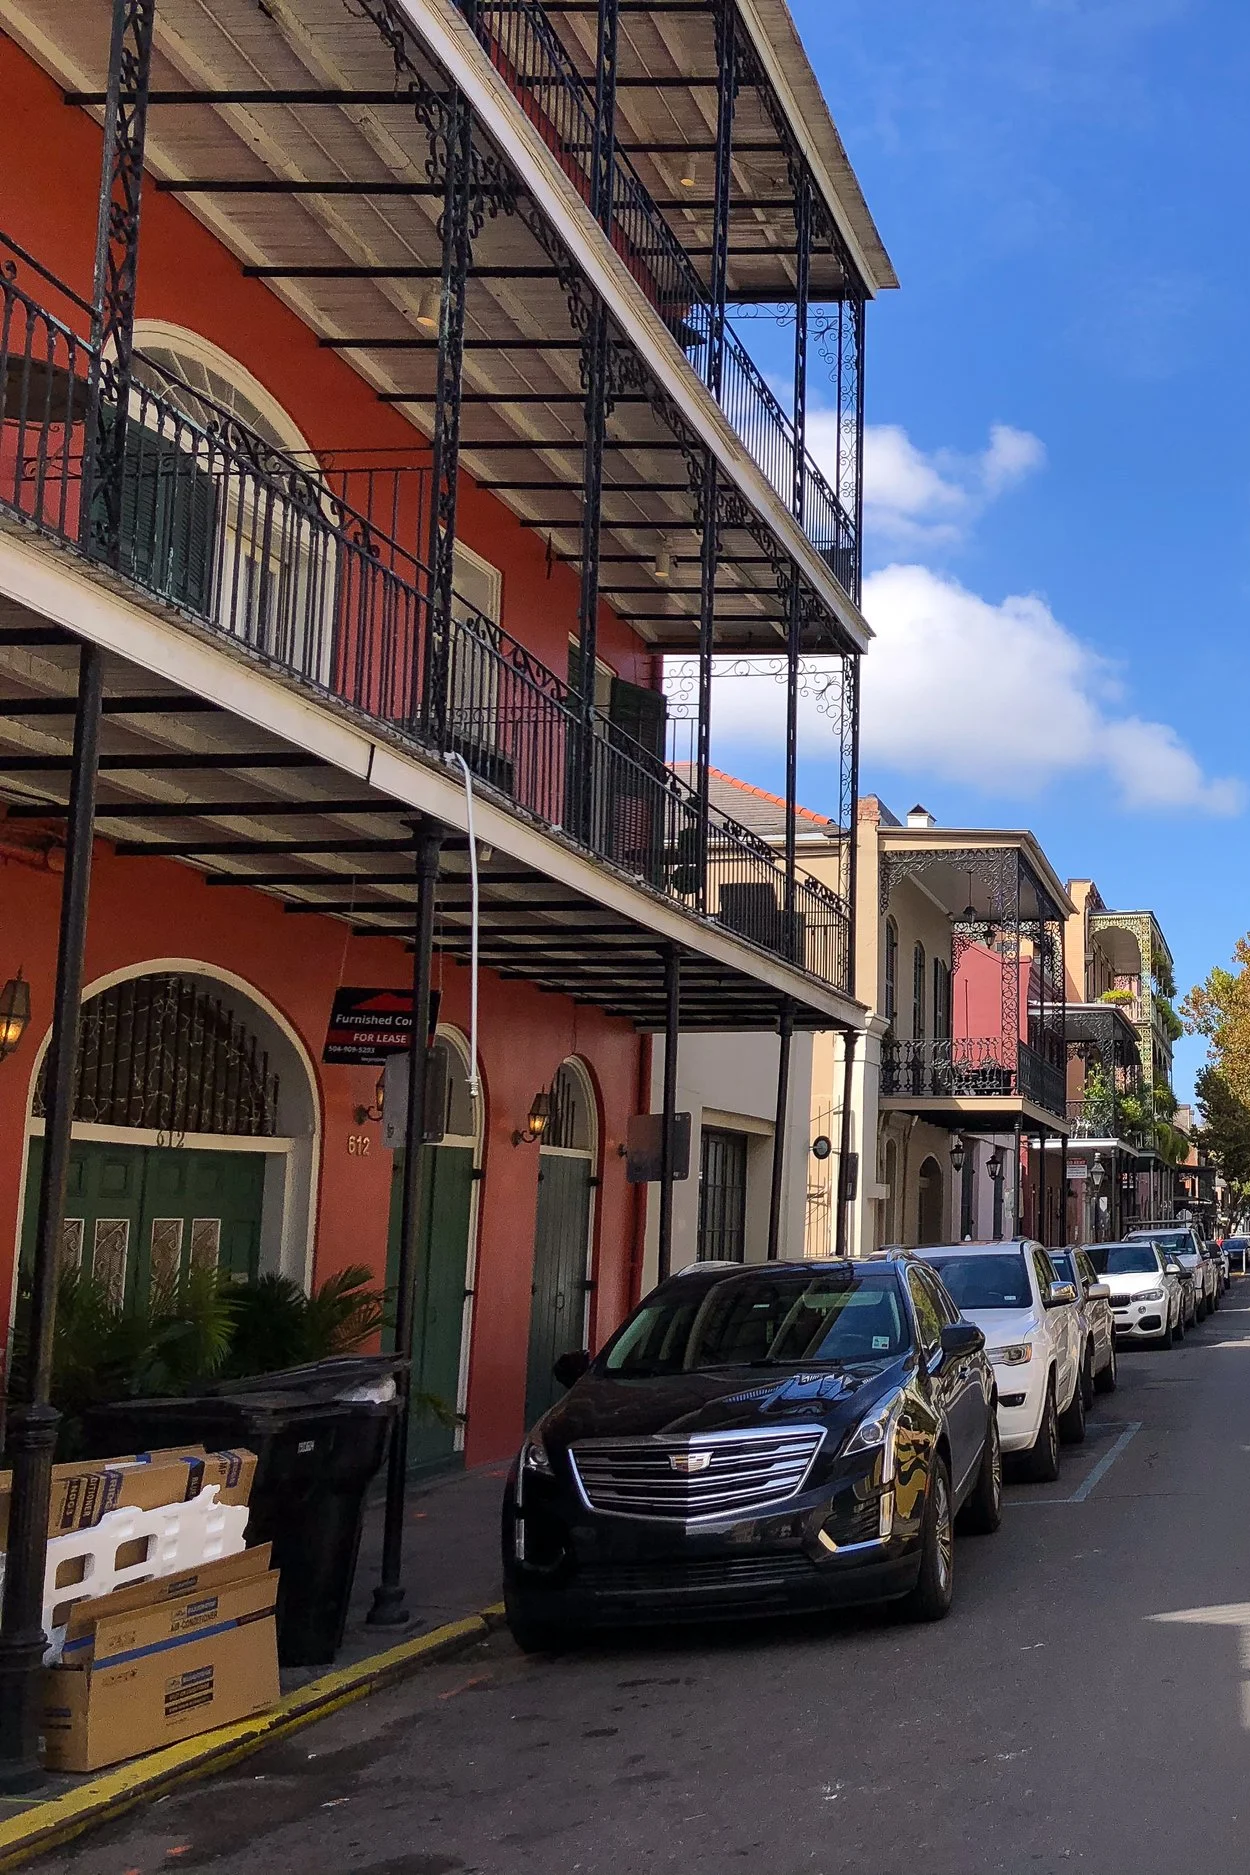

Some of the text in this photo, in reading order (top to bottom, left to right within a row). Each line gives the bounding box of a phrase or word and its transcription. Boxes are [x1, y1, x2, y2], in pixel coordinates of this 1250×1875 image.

[335, 1013, 393, 1026] Furnished
[353, 1033, 407, 1044] FOR LEASE
[156, 1128, 185, 1148] 612
[348, 1135, 370, 1156] 612
[81, 1475, 99, 1517] DITIONER
